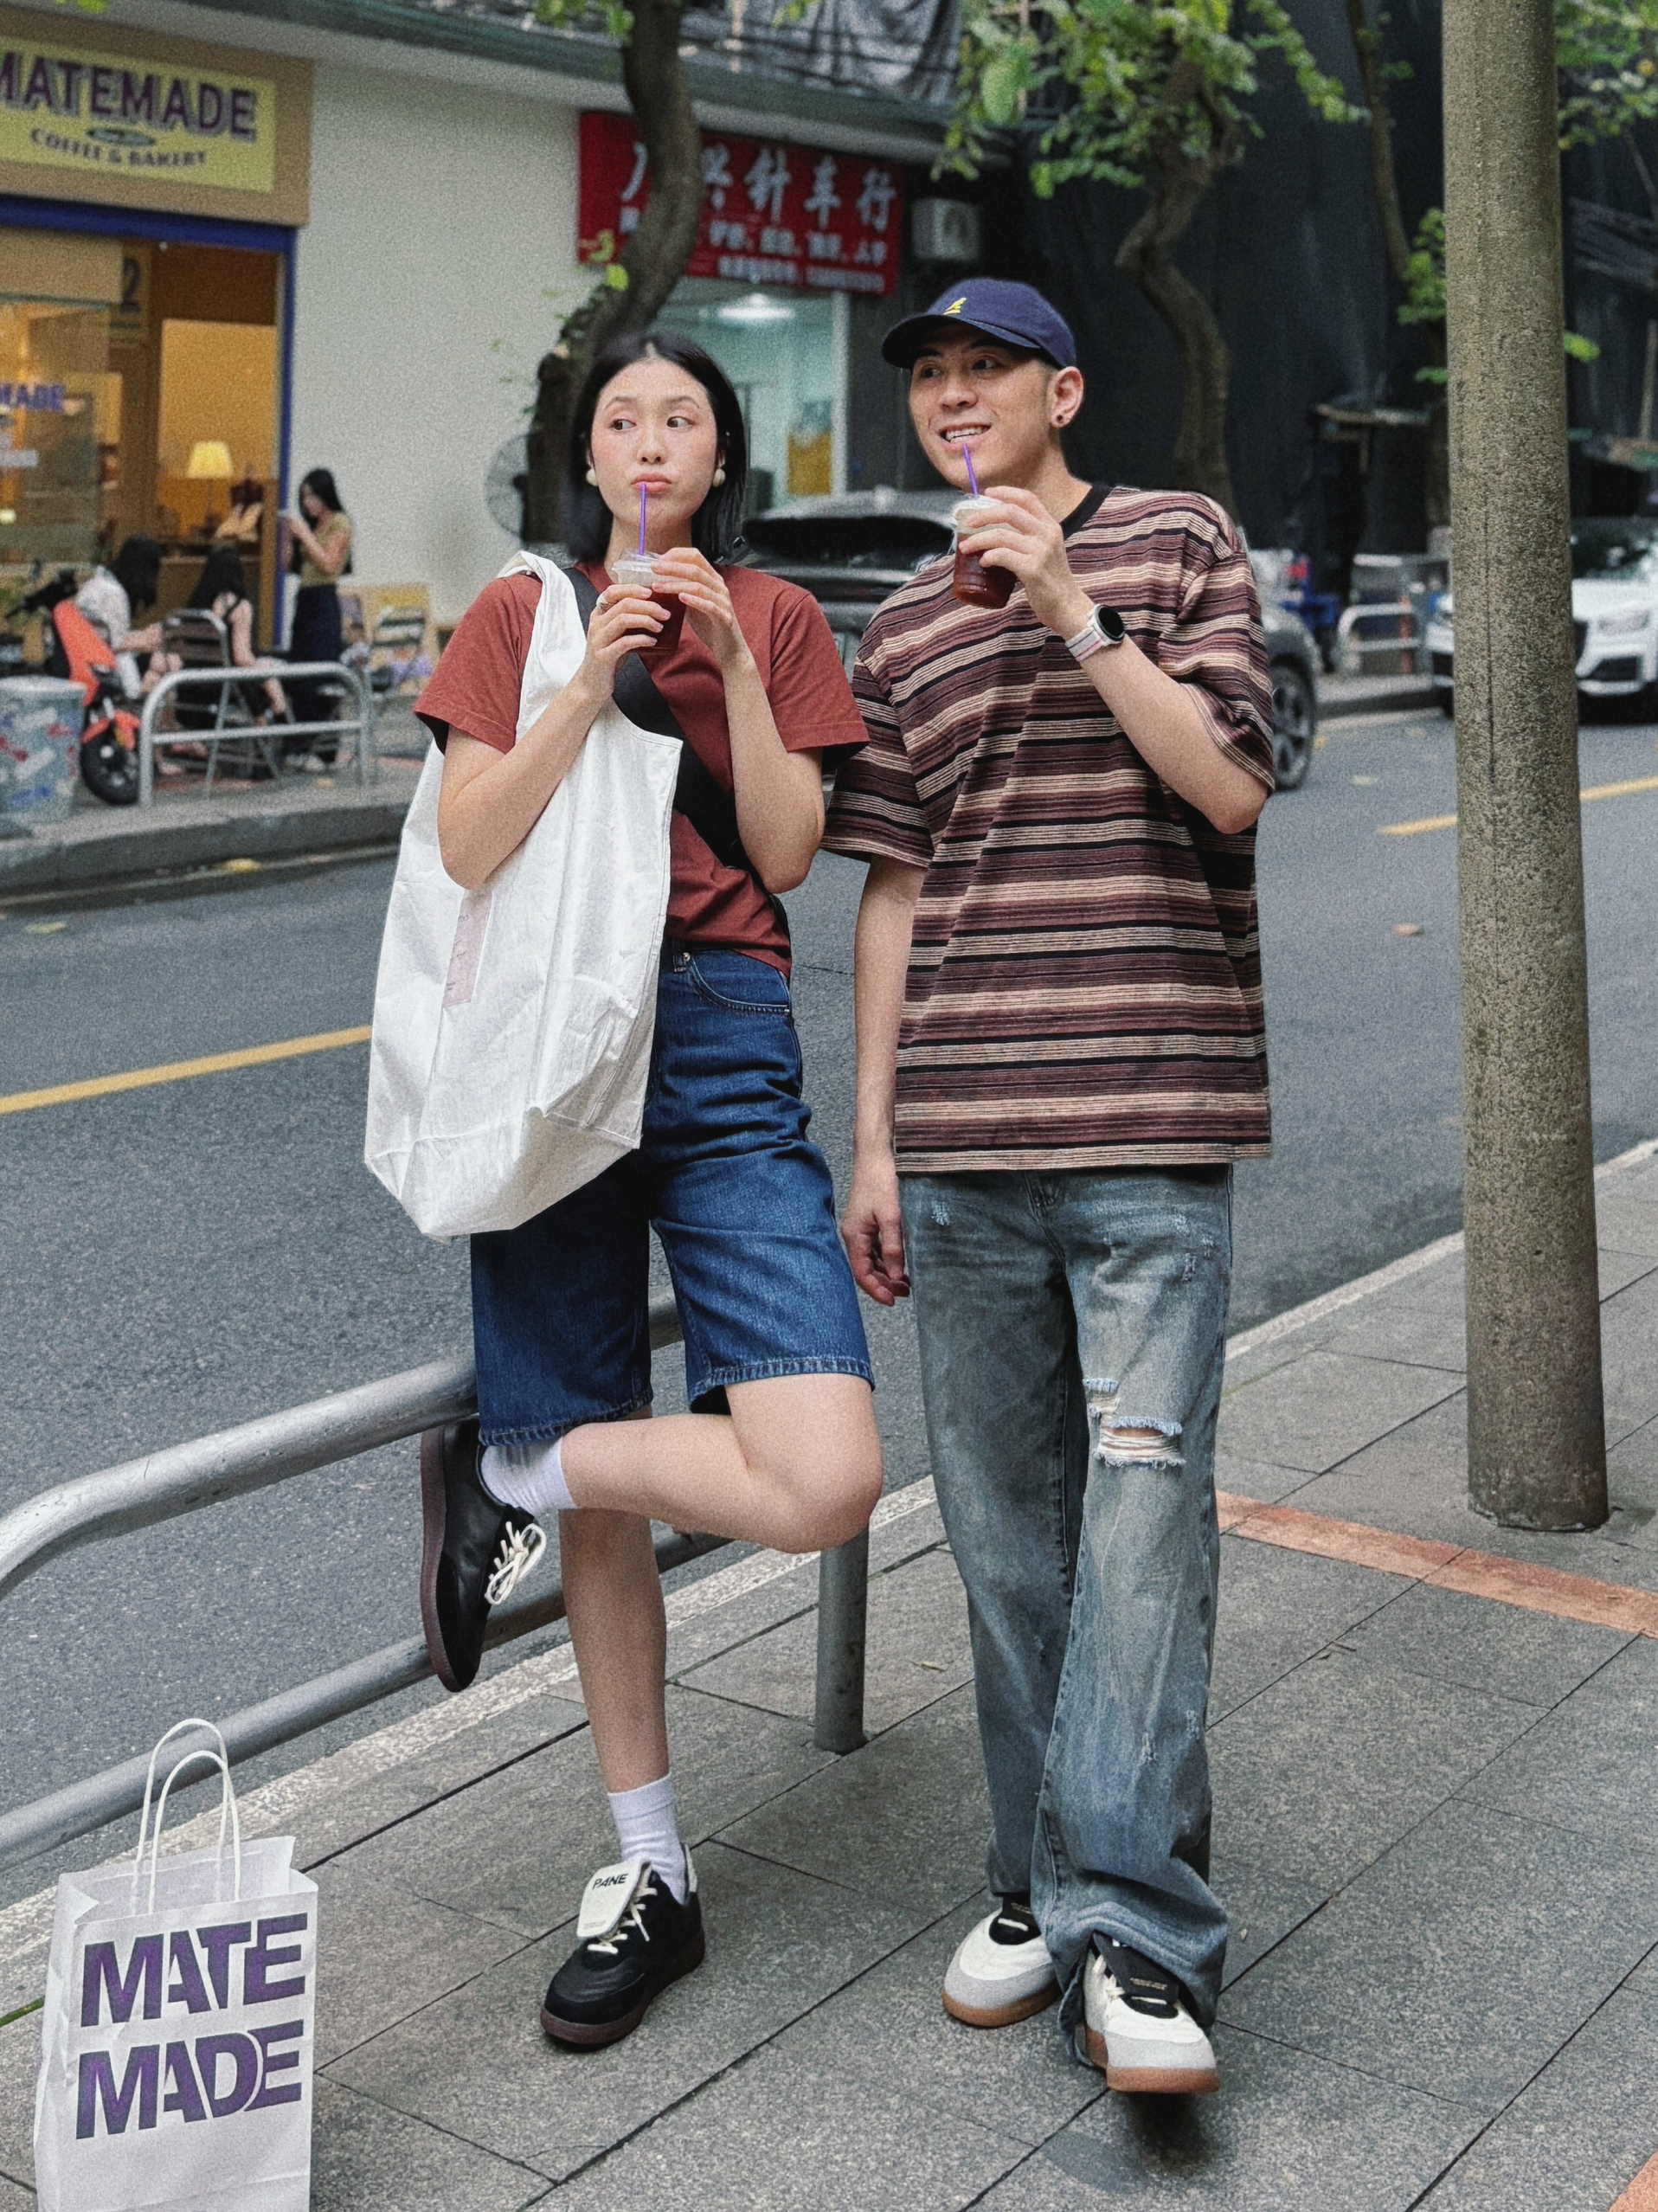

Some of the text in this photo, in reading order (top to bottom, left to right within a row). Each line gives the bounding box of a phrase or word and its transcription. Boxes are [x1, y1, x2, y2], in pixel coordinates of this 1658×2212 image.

[592, 1873, 629, 1890] PANE
[80, 1912, 308, 2028] MATE
[75, 2018, 305, 2140] MADE
